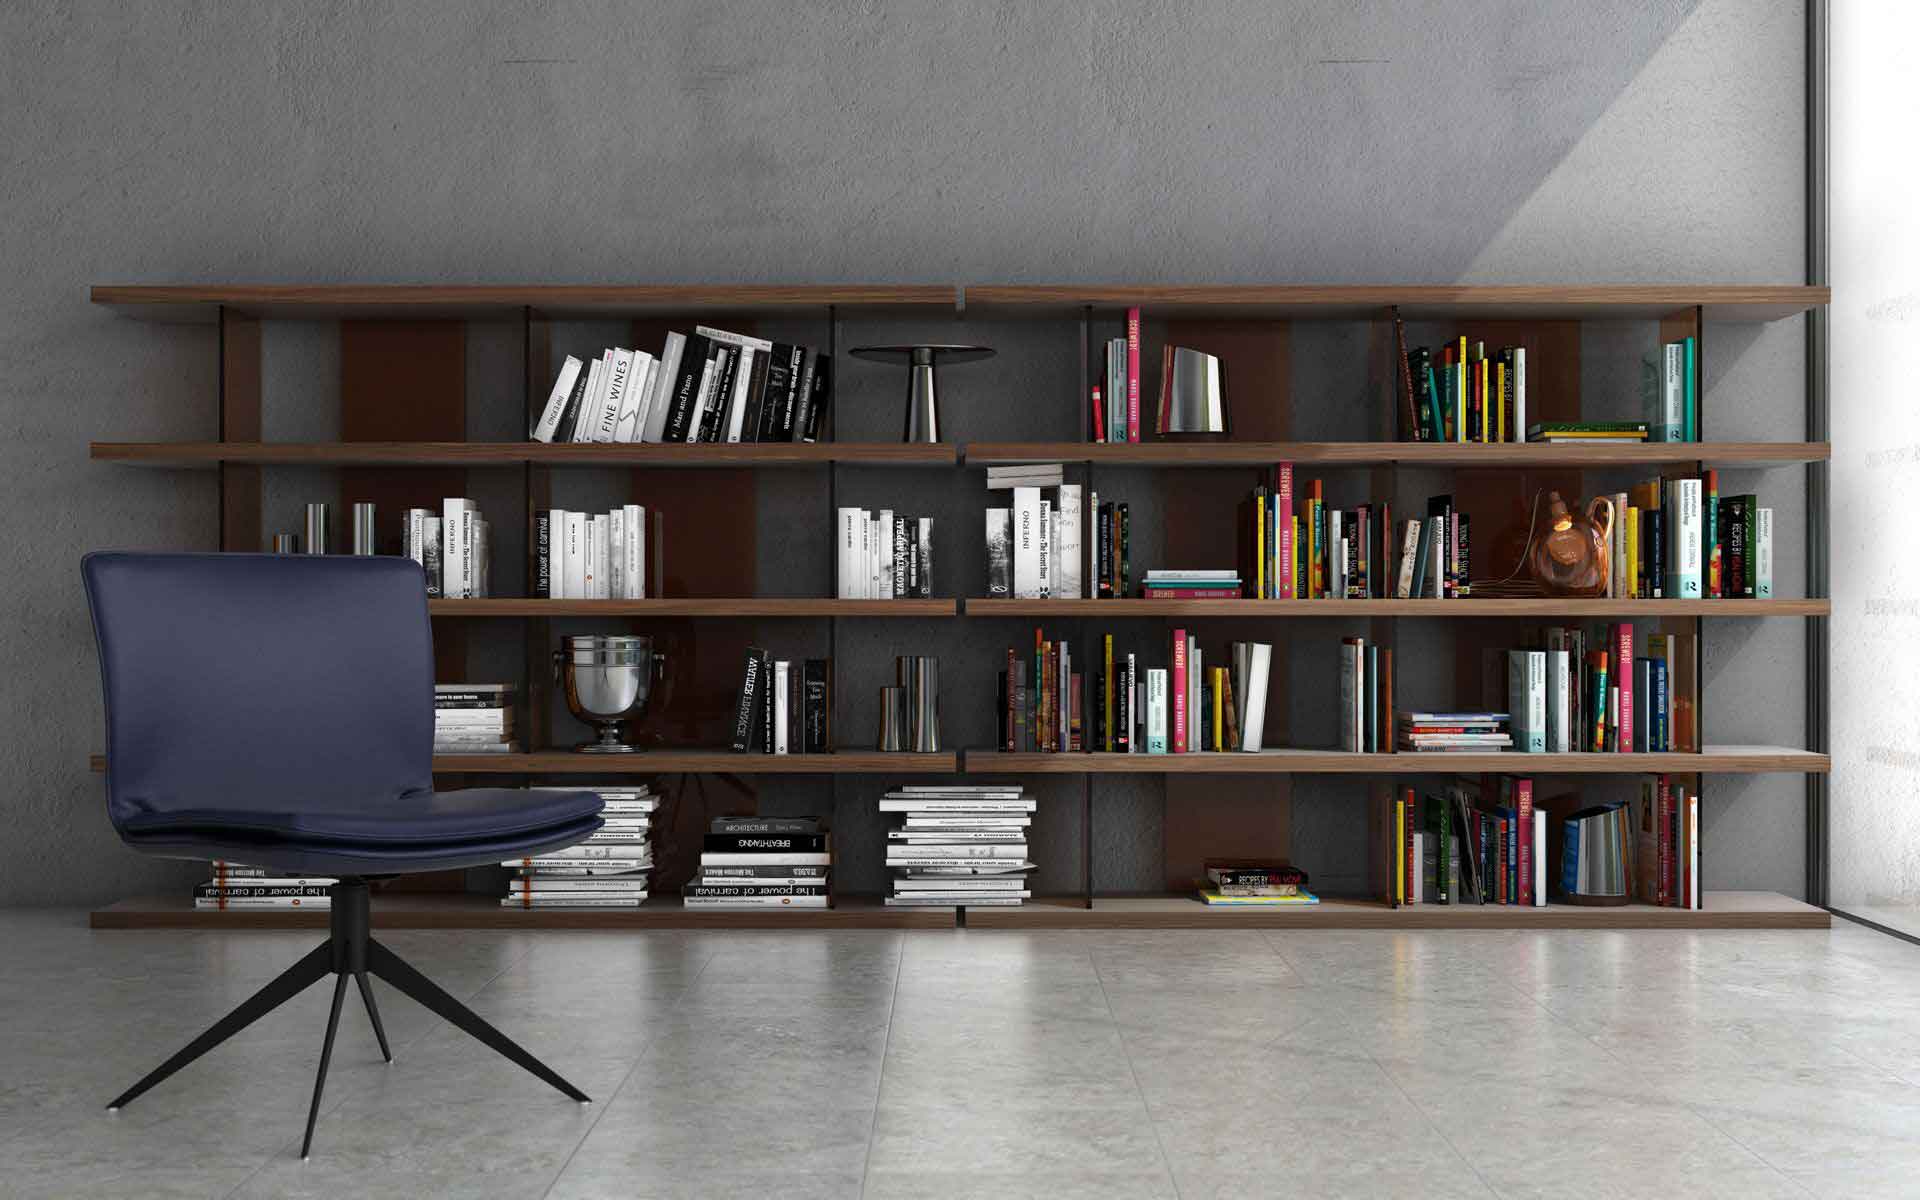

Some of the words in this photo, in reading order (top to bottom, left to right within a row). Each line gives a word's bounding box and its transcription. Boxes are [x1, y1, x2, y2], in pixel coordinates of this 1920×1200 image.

[682, 374, 693, 395] Piano
[601, 404, 617, 433] FINE
[610, 360, 627, 399] WINES
[678, 396, 687, 410] and
[673, 411, 684, 428] Man
[538, 517, 547, 544] carnival
[1732, 524, 1742, 546] RECIPES
[538, 545, 547, 554] of
[1458, 548, 1468, 558] THE
[539, 556, 549, 576] power
[1459, 560, 1468, 578] SHACK
[538, 579, 547, 591] The
[255, 888, 264, 897] of
[271, 886, 303, 896] power
[307, 888, 326, 896] The
[695, 888, 738, 896] carnival
[744, 888, 754, 896] of
[759, 885, 792, 895] power
